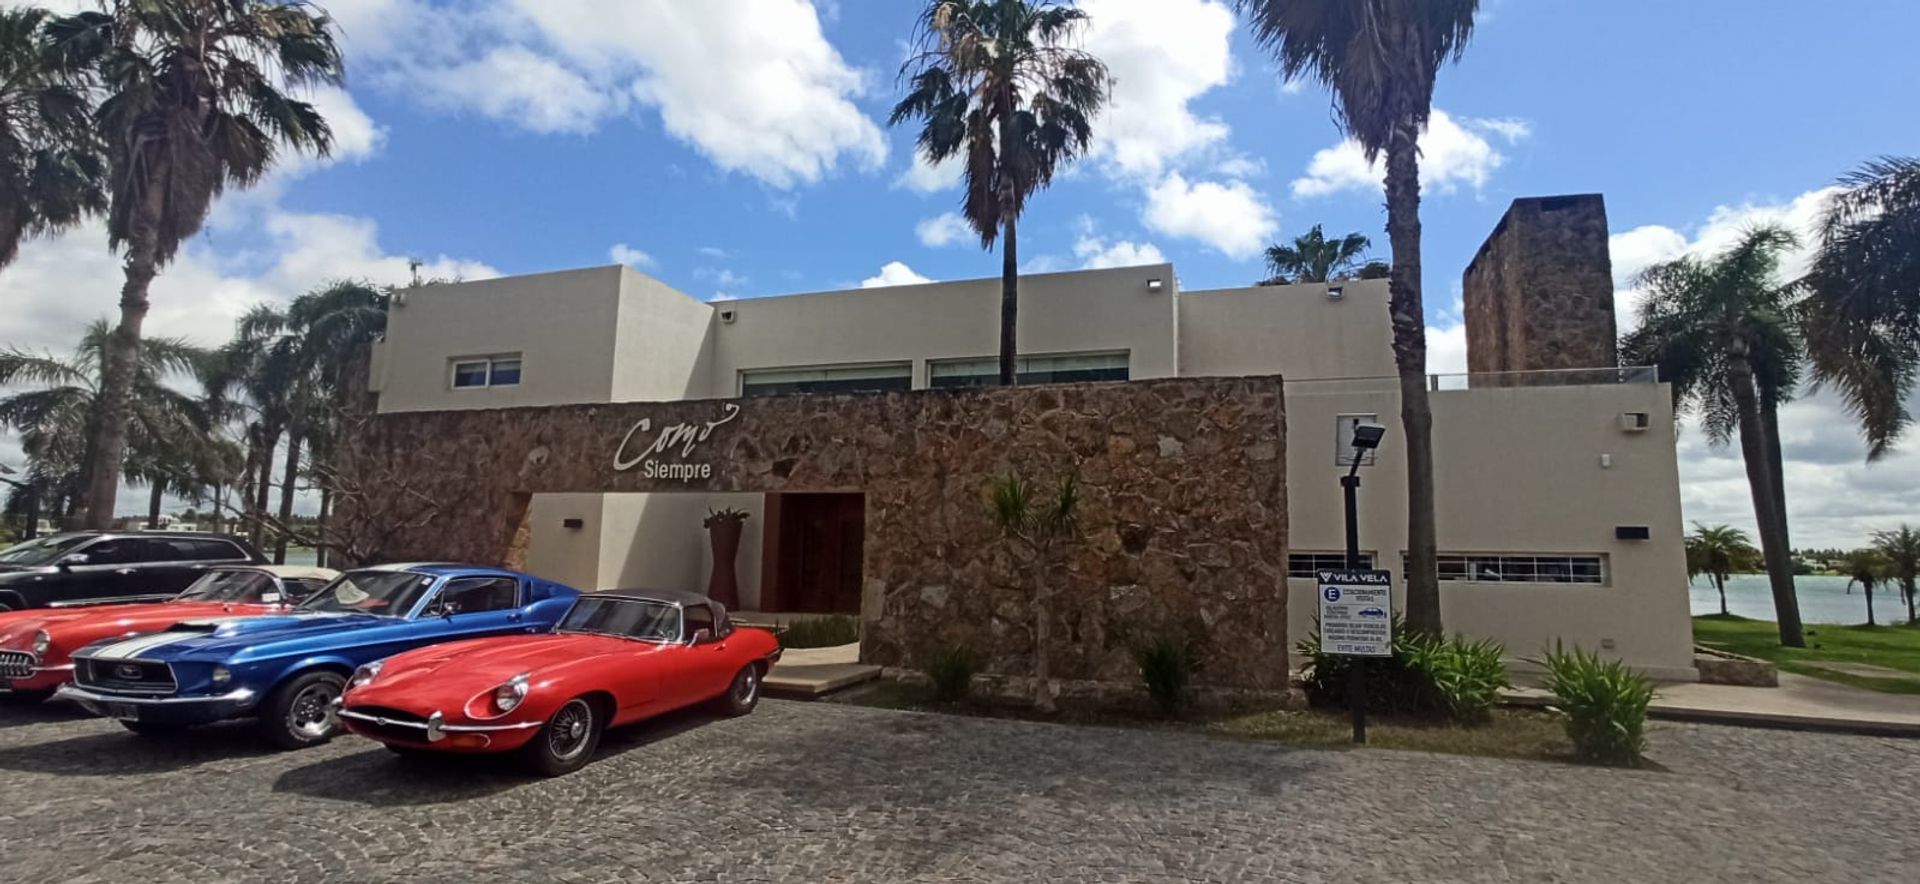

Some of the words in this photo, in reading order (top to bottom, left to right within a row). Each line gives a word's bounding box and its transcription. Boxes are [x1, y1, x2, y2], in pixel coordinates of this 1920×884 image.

[613, 403, 740, 471] Como
[644, 459, 711, 483] Siempre
[1333, 574, 1358, 582] VILA
[1359, 574, 1388, 582] VELA
